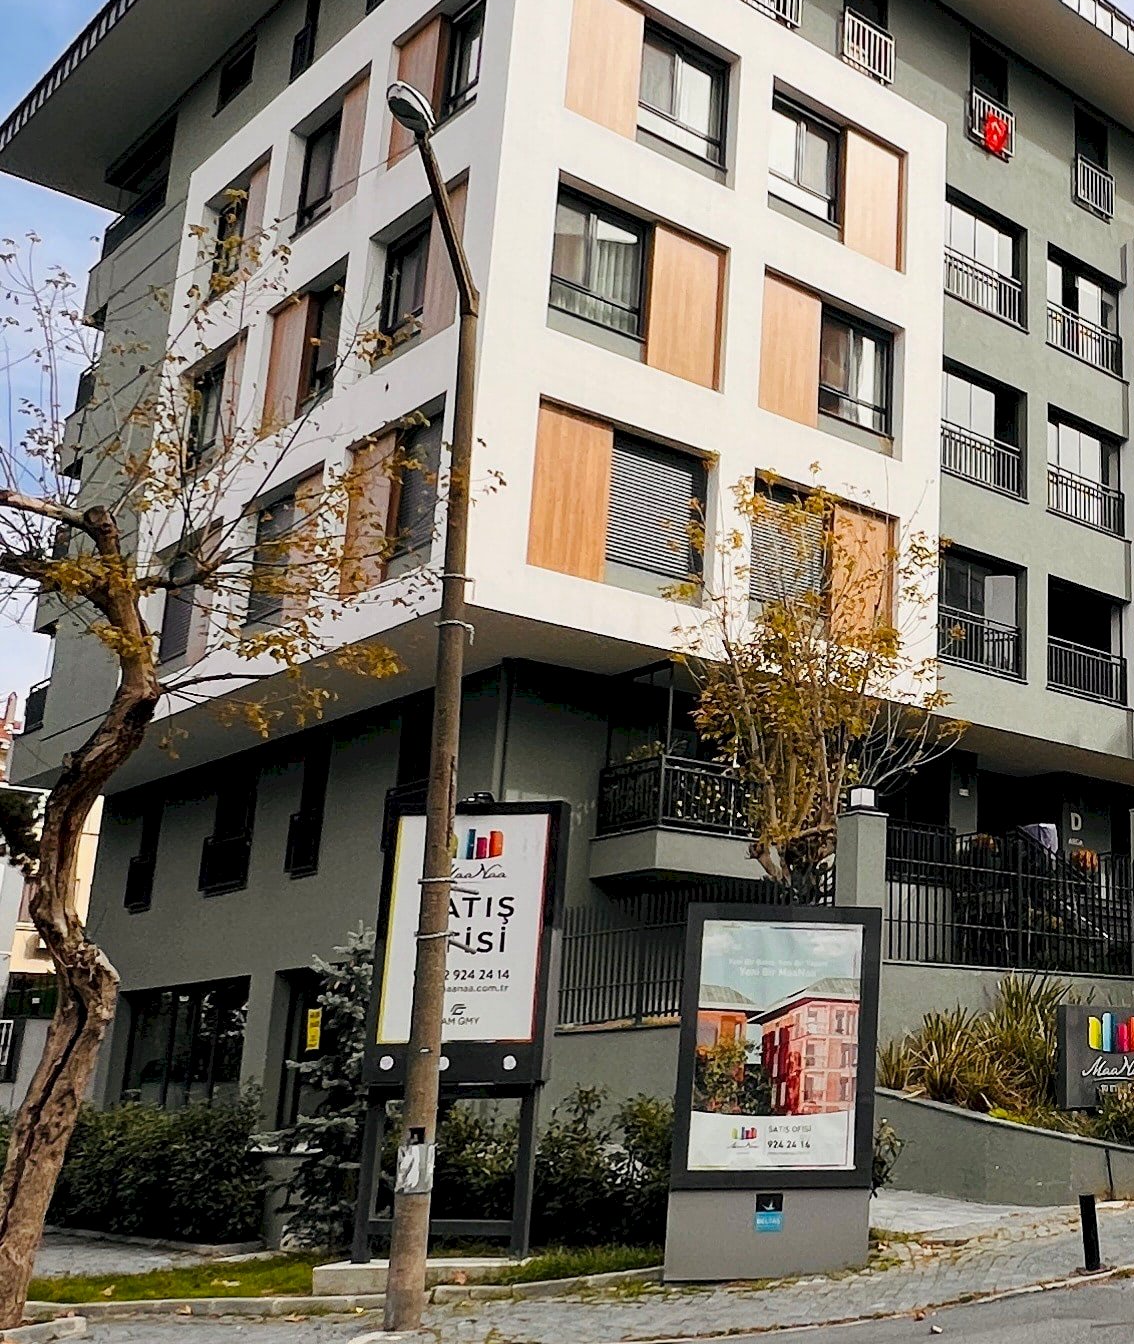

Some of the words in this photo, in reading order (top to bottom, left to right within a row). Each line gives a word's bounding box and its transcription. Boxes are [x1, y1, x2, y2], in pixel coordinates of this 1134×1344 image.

[1070, 812, 1082, 831] D
[448, 896, 515, 925] ATIŞ
[453, 969, 475, 980] 924
[479, 969, 493, 980] 24
[497, 969, 510, 980] 14
[446, 984, 510, 993] aanaa.com.tr
